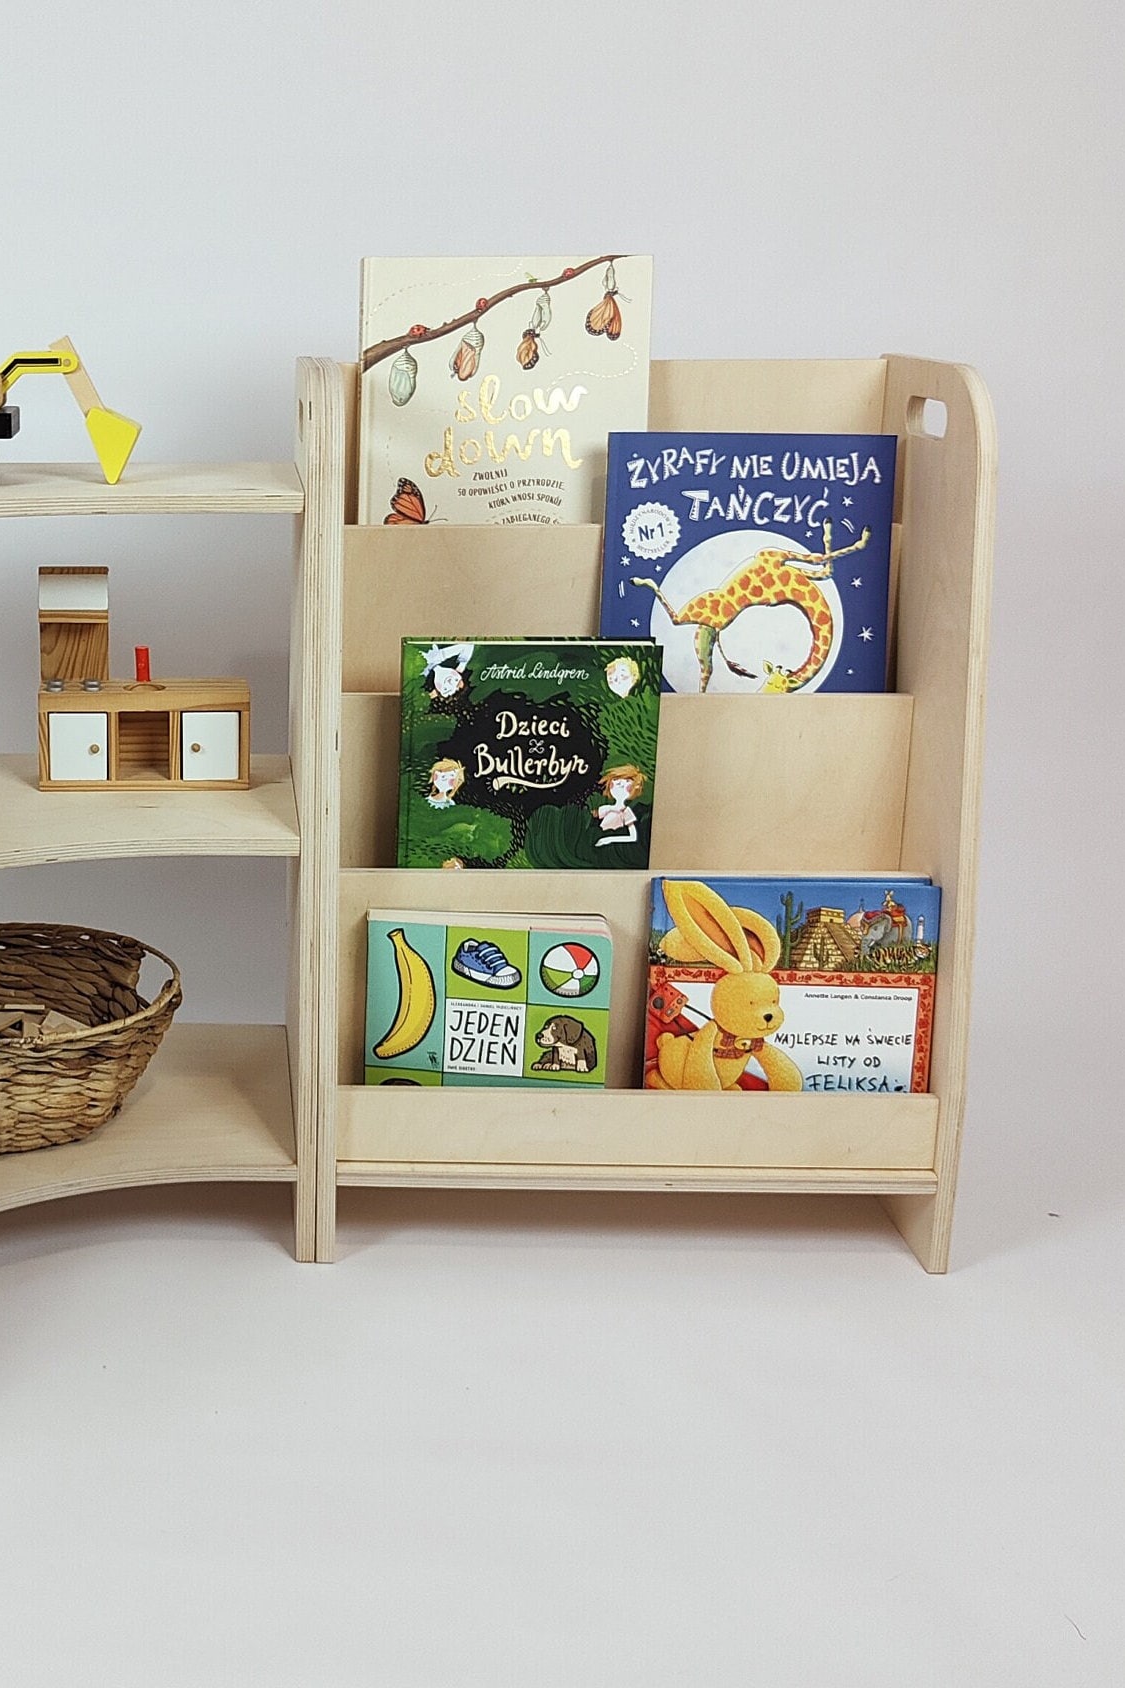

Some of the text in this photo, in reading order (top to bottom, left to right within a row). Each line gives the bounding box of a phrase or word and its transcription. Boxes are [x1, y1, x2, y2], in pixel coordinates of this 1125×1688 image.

[455, 374, 589, 424] slow
[424, 426, 584, 478] down
[473, 468, 508, 481] ZWOLNIJ
[627, 446, 882, 488] ŻYRAFY NIE UMIEJĄ
[458, 488, 467, 496] 50
[468, 483, 508, 496] OPOWIEŚCI
[510, 481, 515, 489] O
[488, 493, 562, 509] KTÓRA WNOSI SPOKÓJ
[681, 484, 830, 528] TAŃCZYĆ
[502, 513, 551, 525] ZABIEGANEGO
[638, 522, 664, 541] Nr 1
[480, 662, 590, 684] Astrid Lindgren
[495, 710, 570, 739] Dzieci
[473, 743, 589, 789] Bullerbyn
[449, 1010, 519, 1037] JEDEN
[774, 1027, 913, 1049] NAJLEPSZE NA ŚWIECIE
[449, 1037, 517, 1065] DZIEŃ
[817, 1055, 881, 1069] LISTY OD
[805, 1074, 890, 1092] FELIKSA
